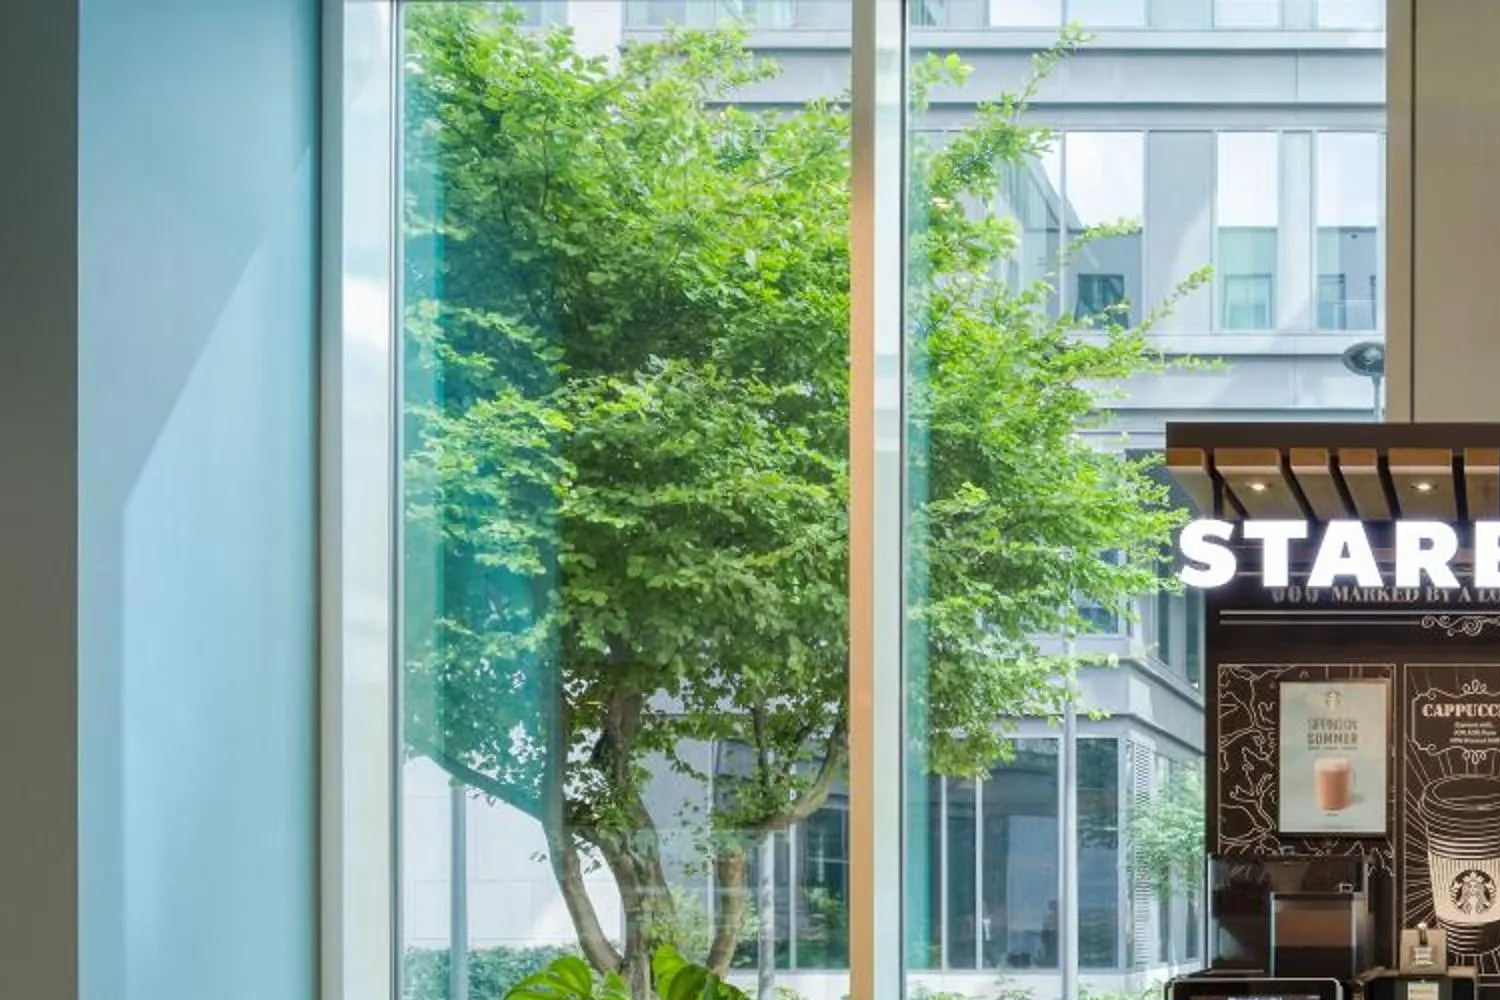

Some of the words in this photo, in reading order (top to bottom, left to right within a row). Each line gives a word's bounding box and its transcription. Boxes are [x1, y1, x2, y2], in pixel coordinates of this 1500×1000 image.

[1332, 585, 1418, 602] MARKED
[1427, 585, 1450, 602] BY
[1459, 585, 1472, 602] A
[1306, 732, 1359, 745] SUMMER
